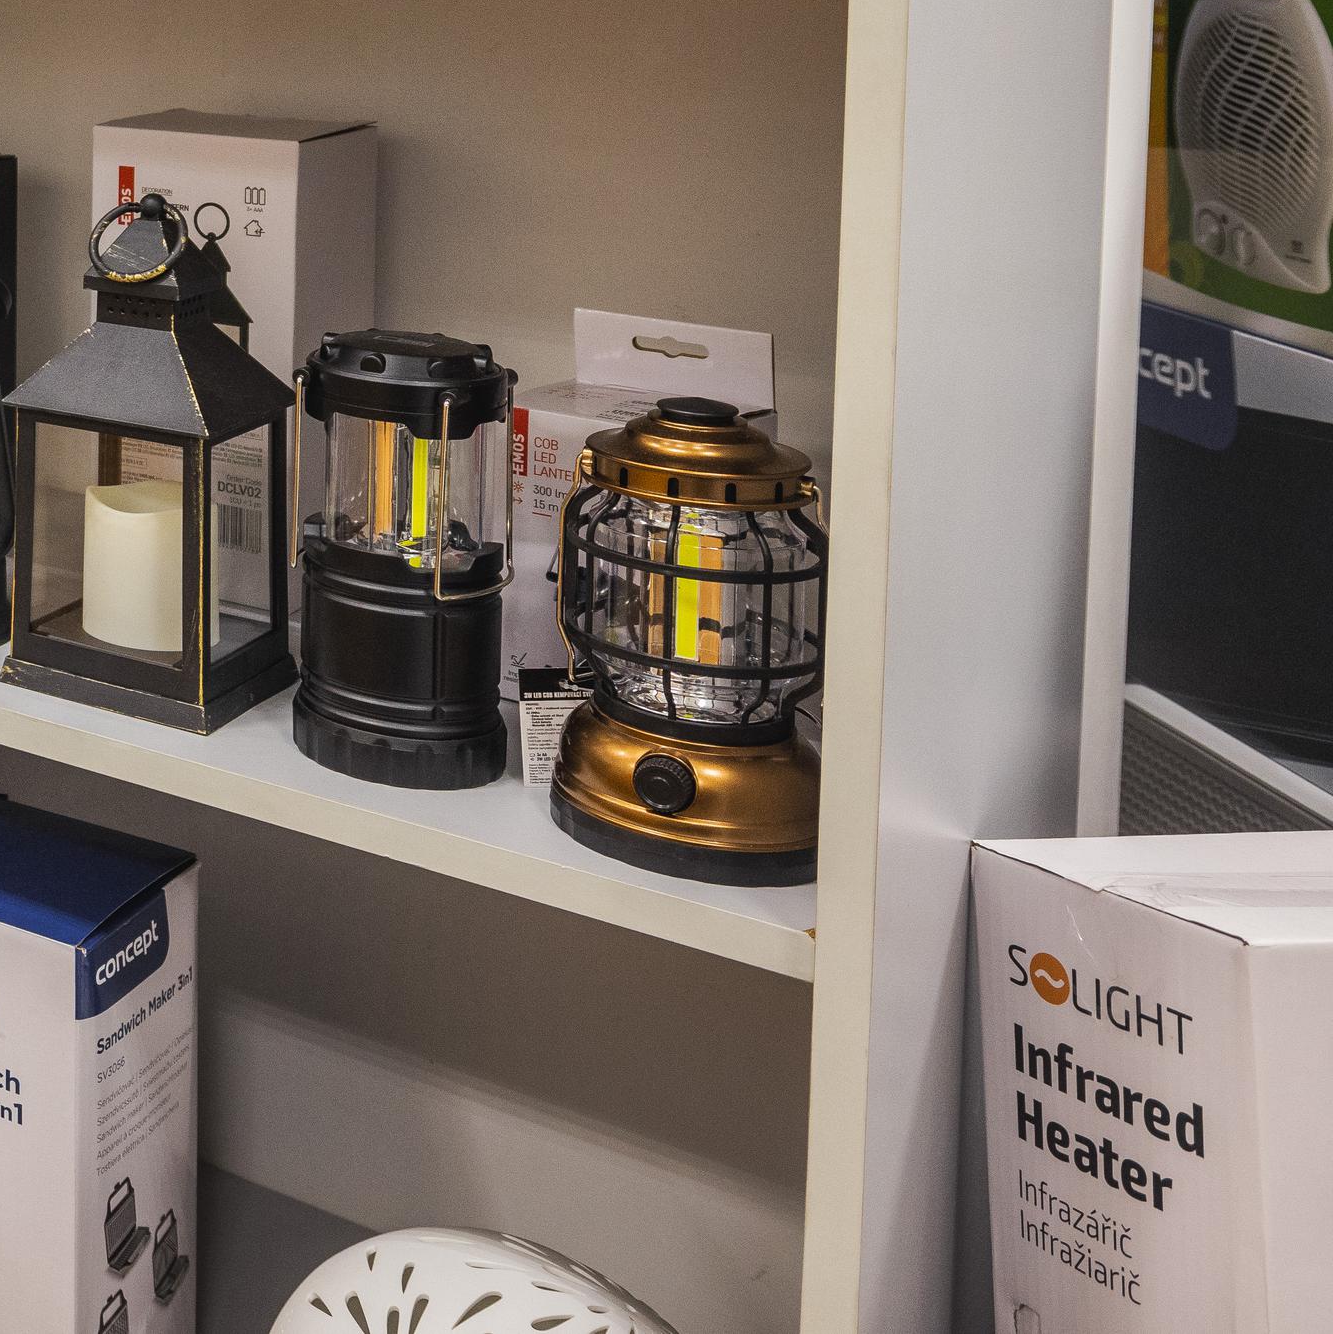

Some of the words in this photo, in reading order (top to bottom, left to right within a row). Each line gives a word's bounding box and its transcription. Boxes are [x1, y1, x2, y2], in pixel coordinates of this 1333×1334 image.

[534, 437, 558, 450] COB
[534, 451, 556, 464] LED
[218, 481, 261, 498] DCLV02
[533, 484, 552, 497] 300
[533, 498, 546, 510] 15
[549, 503, 559, 512] m
[95, 920, 159, 986] concept
[96, 1006, 146, 1055] Sandwich
[148, 983, 176, 1018] Maker
[177, 967, 194, 991] 3in1
[1008, 944, 1192, 1055] SOLIGHT
[96, 1056, 126, 1084] SV3056
[1014, 1022, 1205, 1159] Infrared
[96, 1115, 126, 1144] Sandwich
[1016, 1090, 1173, 1212] Heater
[1019, 1169, 1132, 1259] Infrazářič
[1020, 1210, 1141, 1306] Infražiarič
